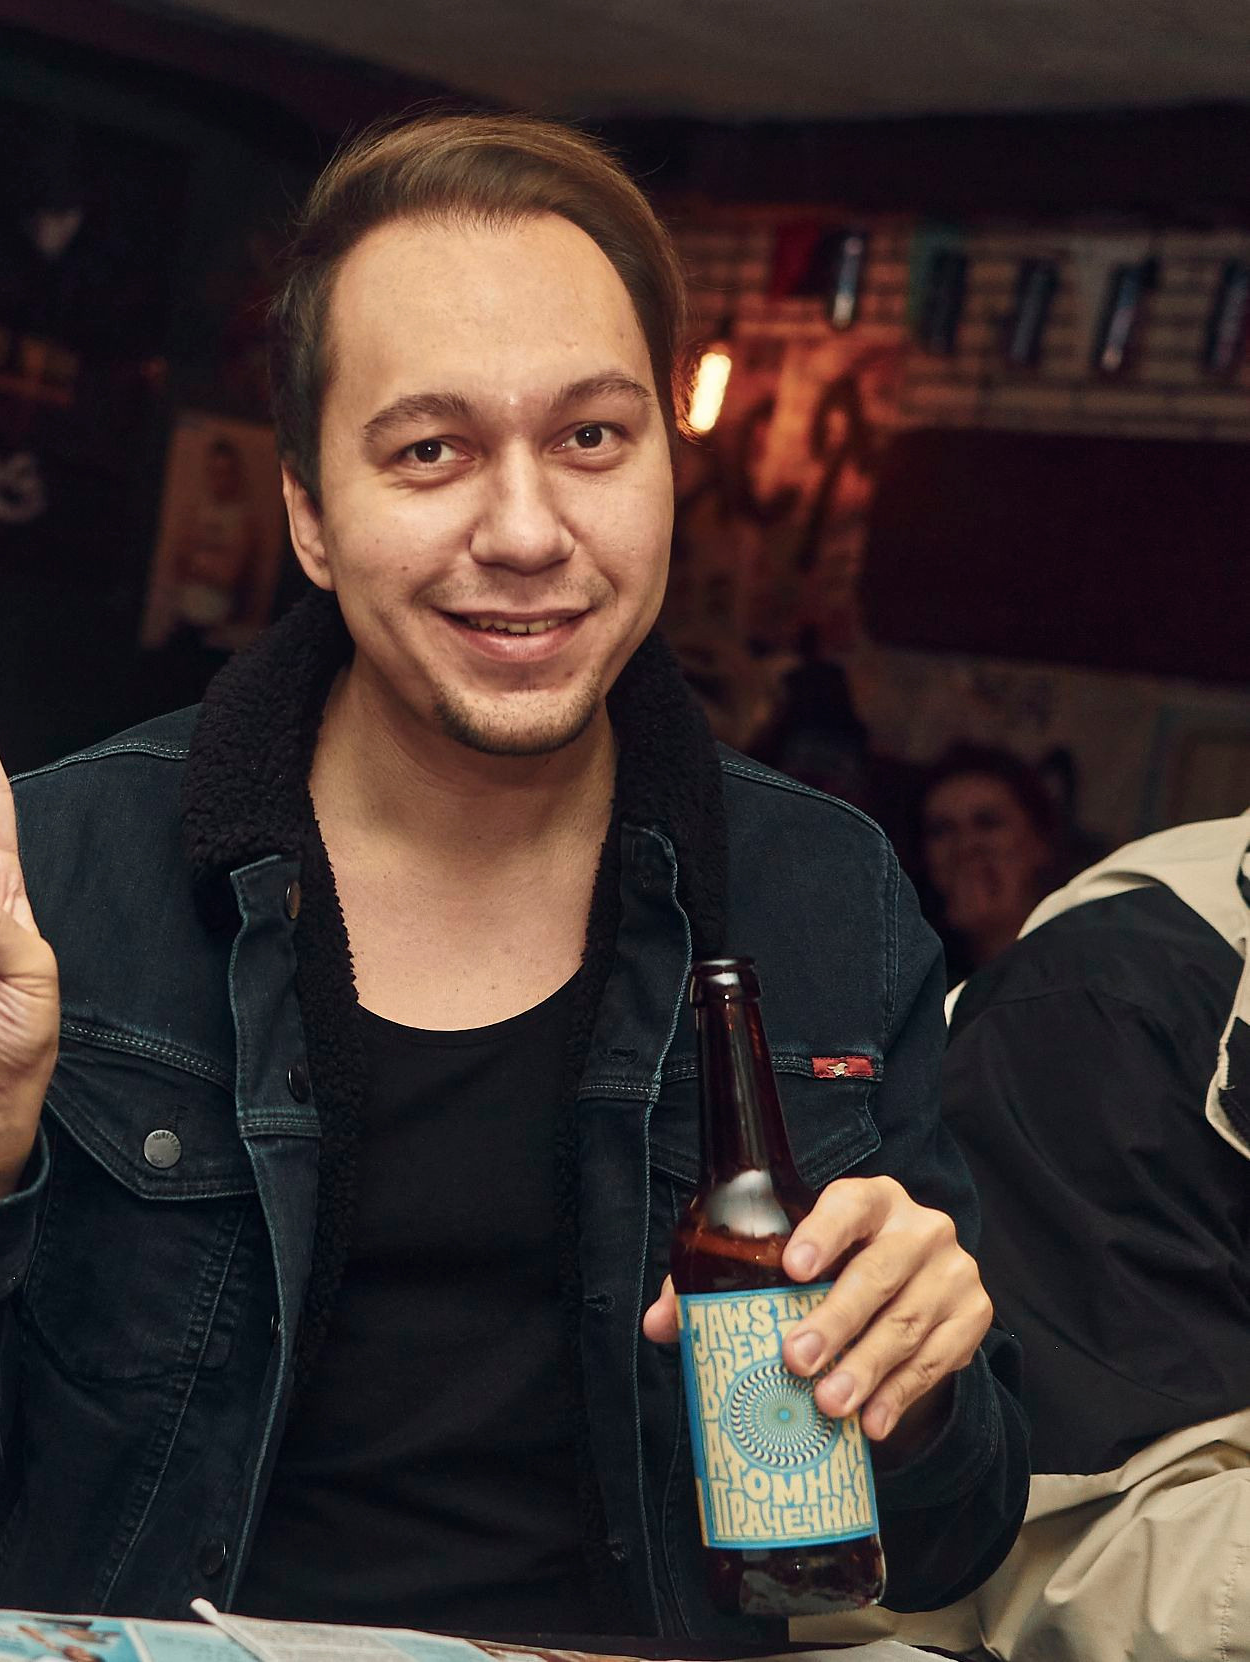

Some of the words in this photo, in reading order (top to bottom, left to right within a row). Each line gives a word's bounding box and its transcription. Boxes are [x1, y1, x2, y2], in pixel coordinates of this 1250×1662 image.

[689, 1297, 774, 1363] JAWS
[706, 1414, 863, 1505] АТОМНАЯ
[711, 1464, 872, 1537] ПРАЧЕЧНАЯ
